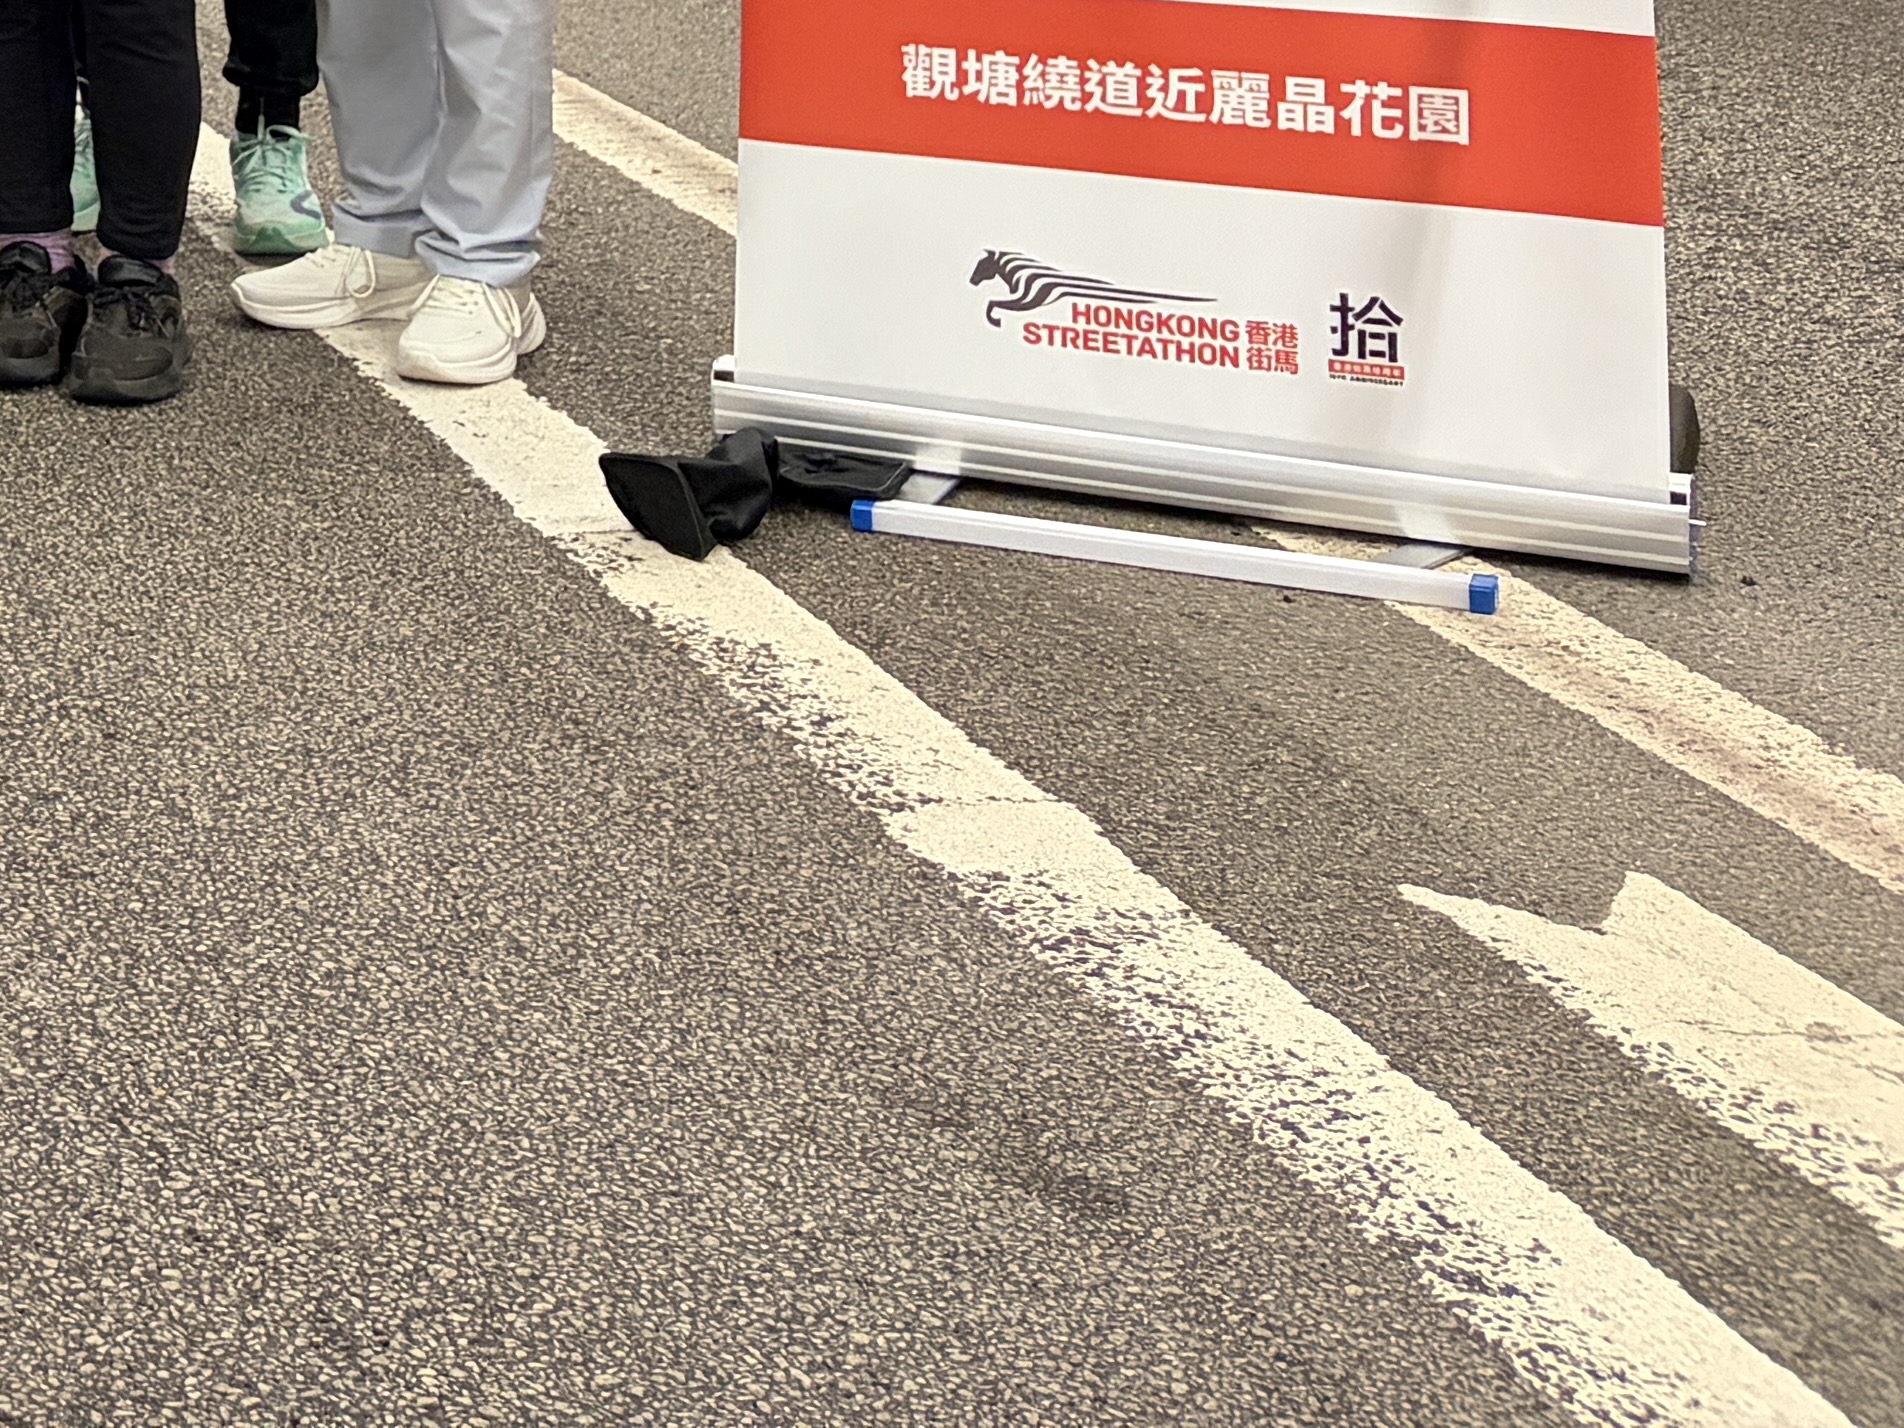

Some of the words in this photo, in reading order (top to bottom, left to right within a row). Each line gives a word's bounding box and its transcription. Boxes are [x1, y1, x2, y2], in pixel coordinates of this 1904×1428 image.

[900, 43, 1470, 146] 觀塘繞道近麗晶花園
[1022, 322, 1240, 369] STREETATHON
[1247, 347, 1299, 375] 街馬
[1071, 302, 1240, 343] HONGKONG
[1245, 320, 1299, 349] 香港
[1329, 293, 1404, 363] 拾
